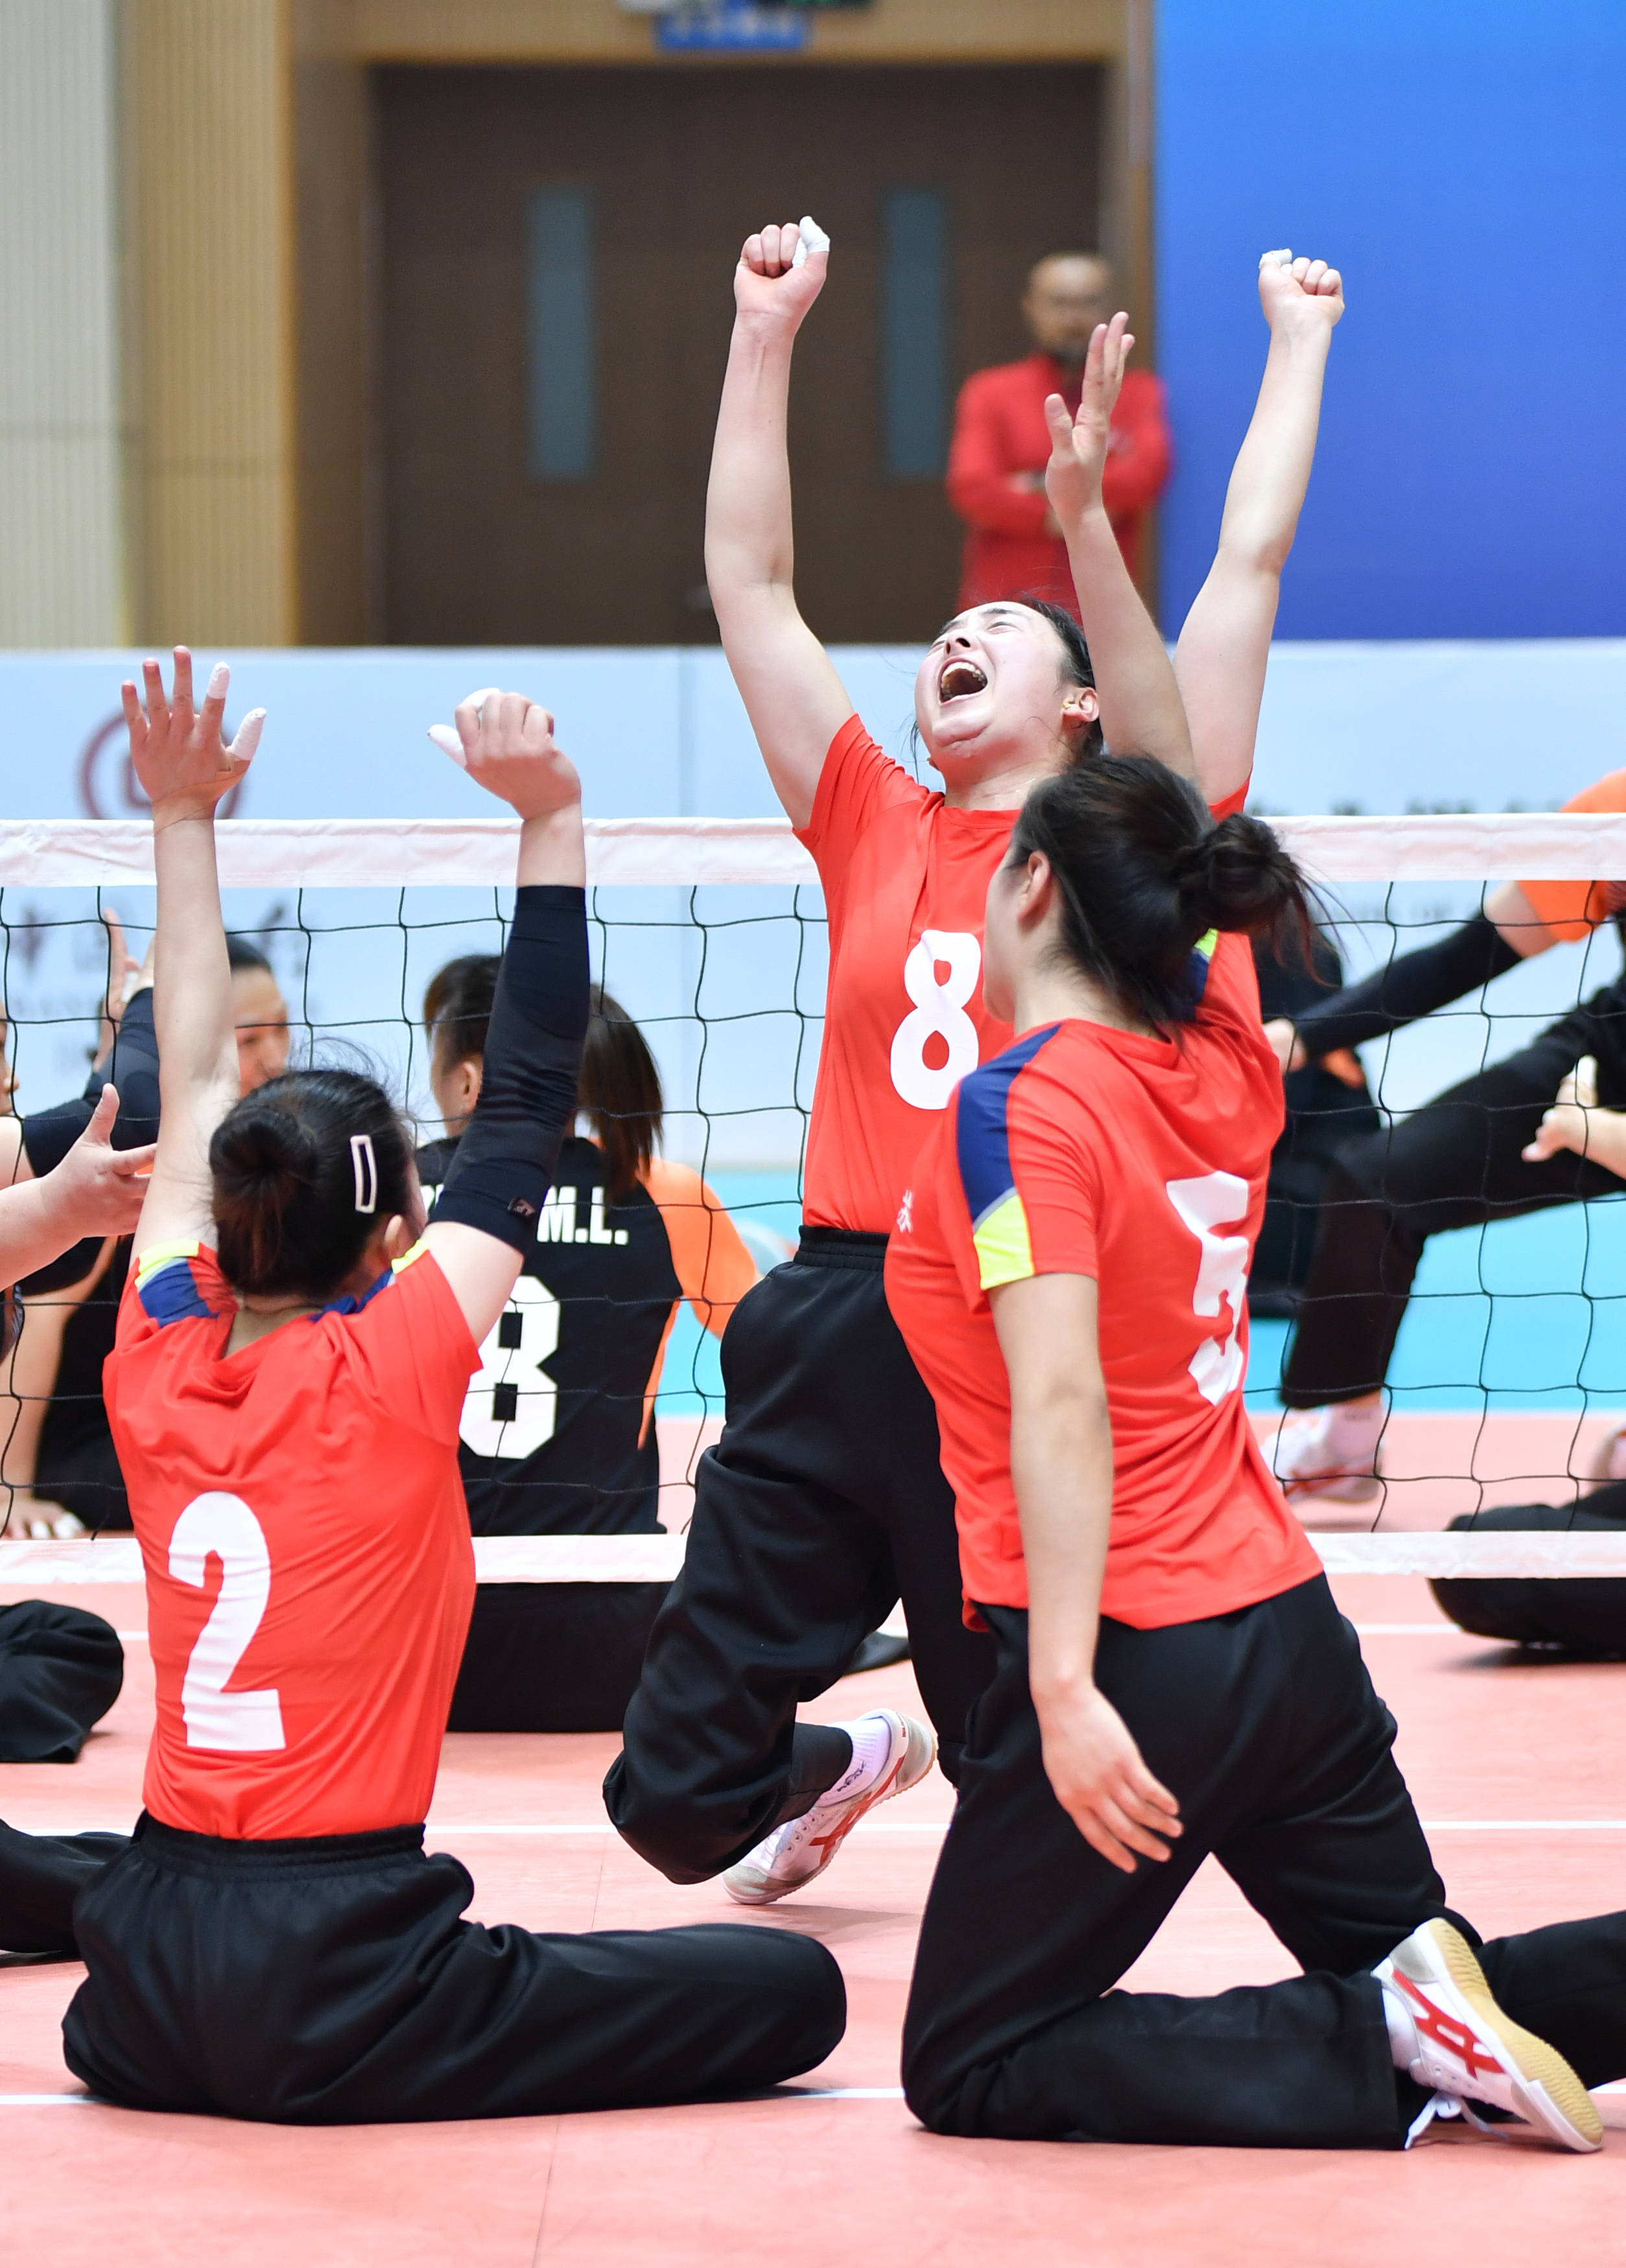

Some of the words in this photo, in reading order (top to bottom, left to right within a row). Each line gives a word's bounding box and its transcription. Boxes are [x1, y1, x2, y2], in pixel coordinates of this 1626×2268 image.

[890, 929, 981, 1110] 8
[537, 1185, 629, 1246] M.L.
[1166, 1170, 1249, 1406] 5
[458, 1275, 560, 1459] 8
[168, 1491, 286, 1751] 2
